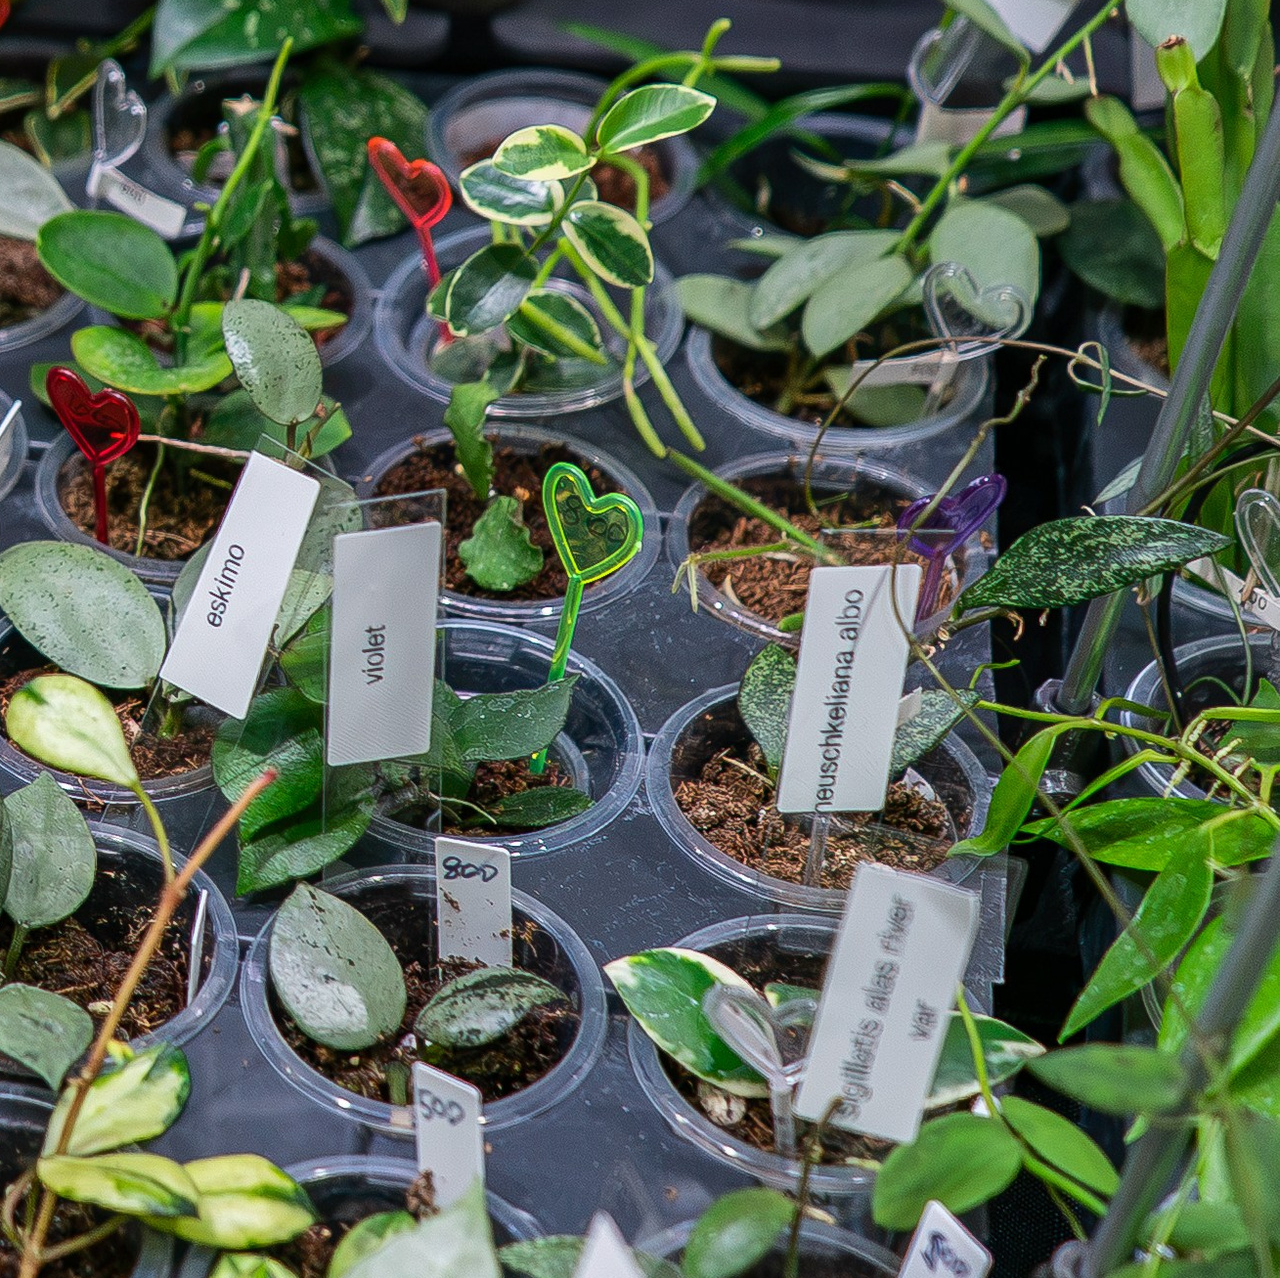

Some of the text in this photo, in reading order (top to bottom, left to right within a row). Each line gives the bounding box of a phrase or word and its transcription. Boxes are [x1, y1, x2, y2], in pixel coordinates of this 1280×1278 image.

[206, 543, 245, 628] eskimo
[834, 589, 864, 641] albo
[361, 624, 386, 685] violet
[442, 855, 498, 883] 800
